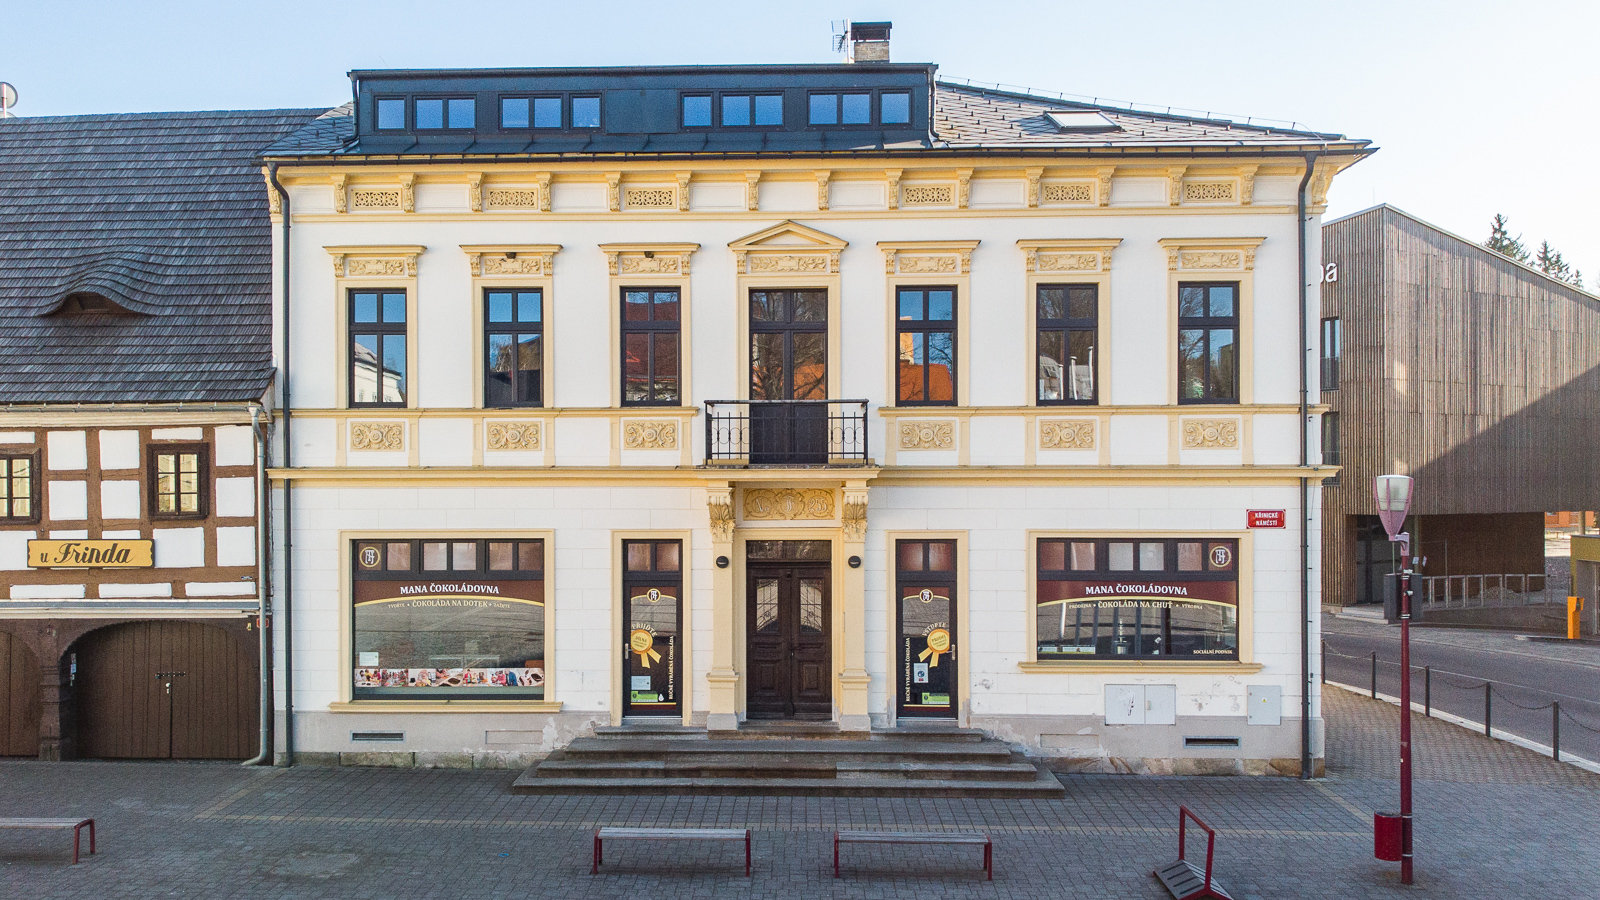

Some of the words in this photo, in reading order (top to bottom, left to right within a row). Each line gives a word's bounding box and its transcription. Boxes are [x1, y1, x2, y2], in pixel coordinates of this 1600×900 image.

[40, 552, 48, 563] u
[400, 586, 428, 594] MANA
[430, 582, 500, 594] ČOKOLÁDOVNA
[1086, 586, 1114, 595] MANA
[1116, 582, 1188, 595] ČOKOLÁDOVNA
[412, 599, 450, 608] ČOKOLÁDA
[1098, 600, 1138, 609] ČOKOLÁDA
[1152, 600, 1173, 609] CHUŤ
